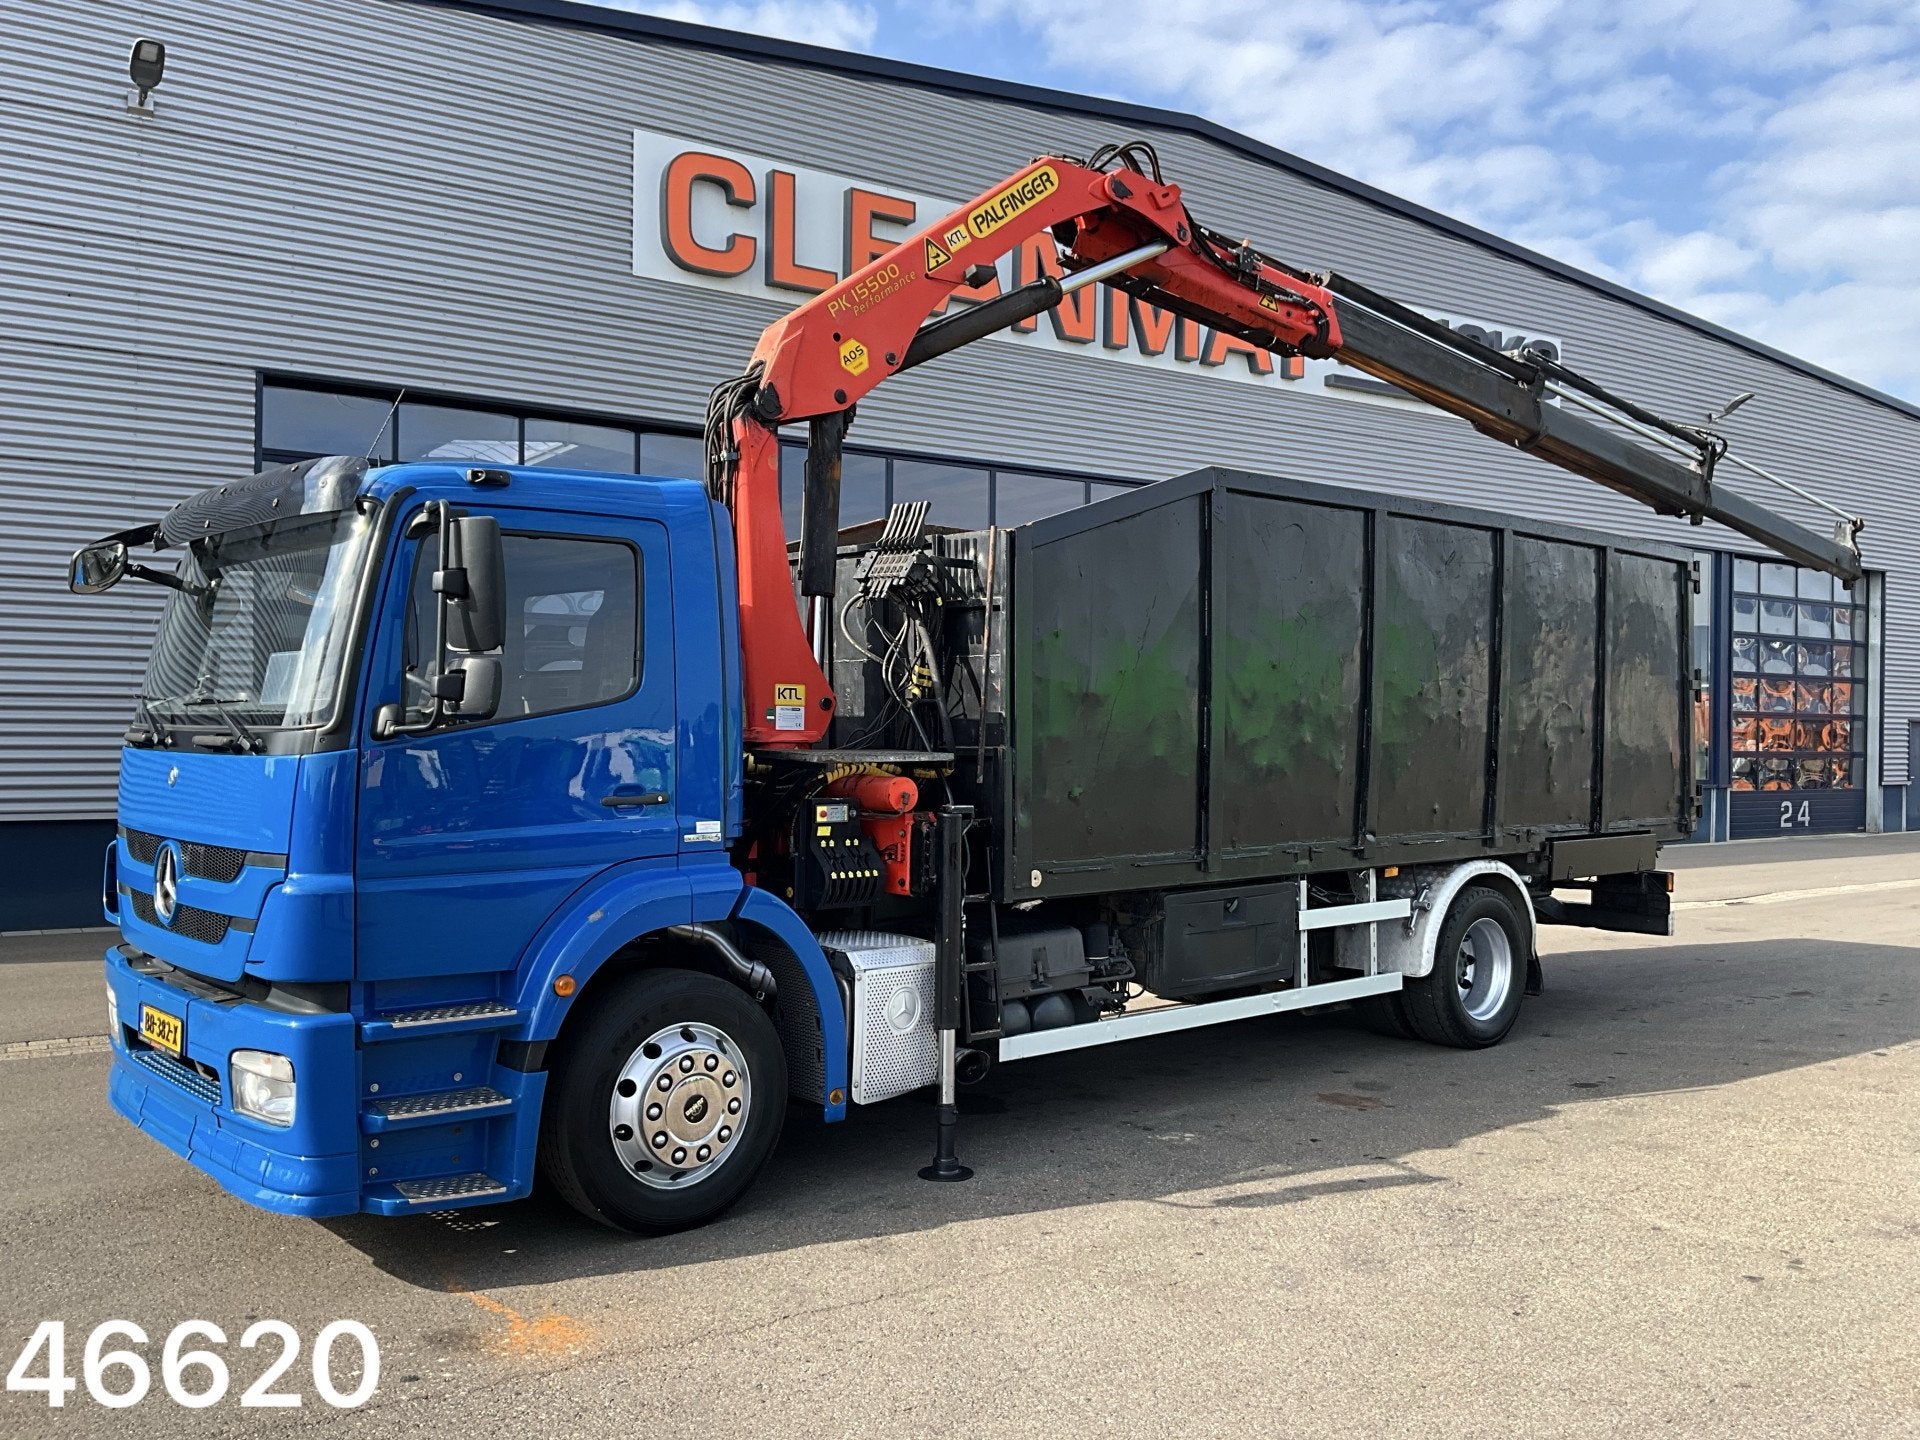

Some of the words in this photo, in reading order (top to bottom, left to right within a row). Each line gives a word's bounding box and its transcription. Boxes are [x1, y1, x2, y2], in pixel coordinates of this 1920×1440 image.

[971, 171, 1055, 234] PALFINGER
[946, 229, 967, 247] KTL
[661, 151, 1304, 381] CLENM
[826, 294, 851, 318] PK
[851, 263, 900, 303] 15500
[852, 270, 917, 317] Performance
[842, 345, 864, 365] AOS
[777, 687, 802, 700] KTL
[1780, 800, 1811, 828] 24
